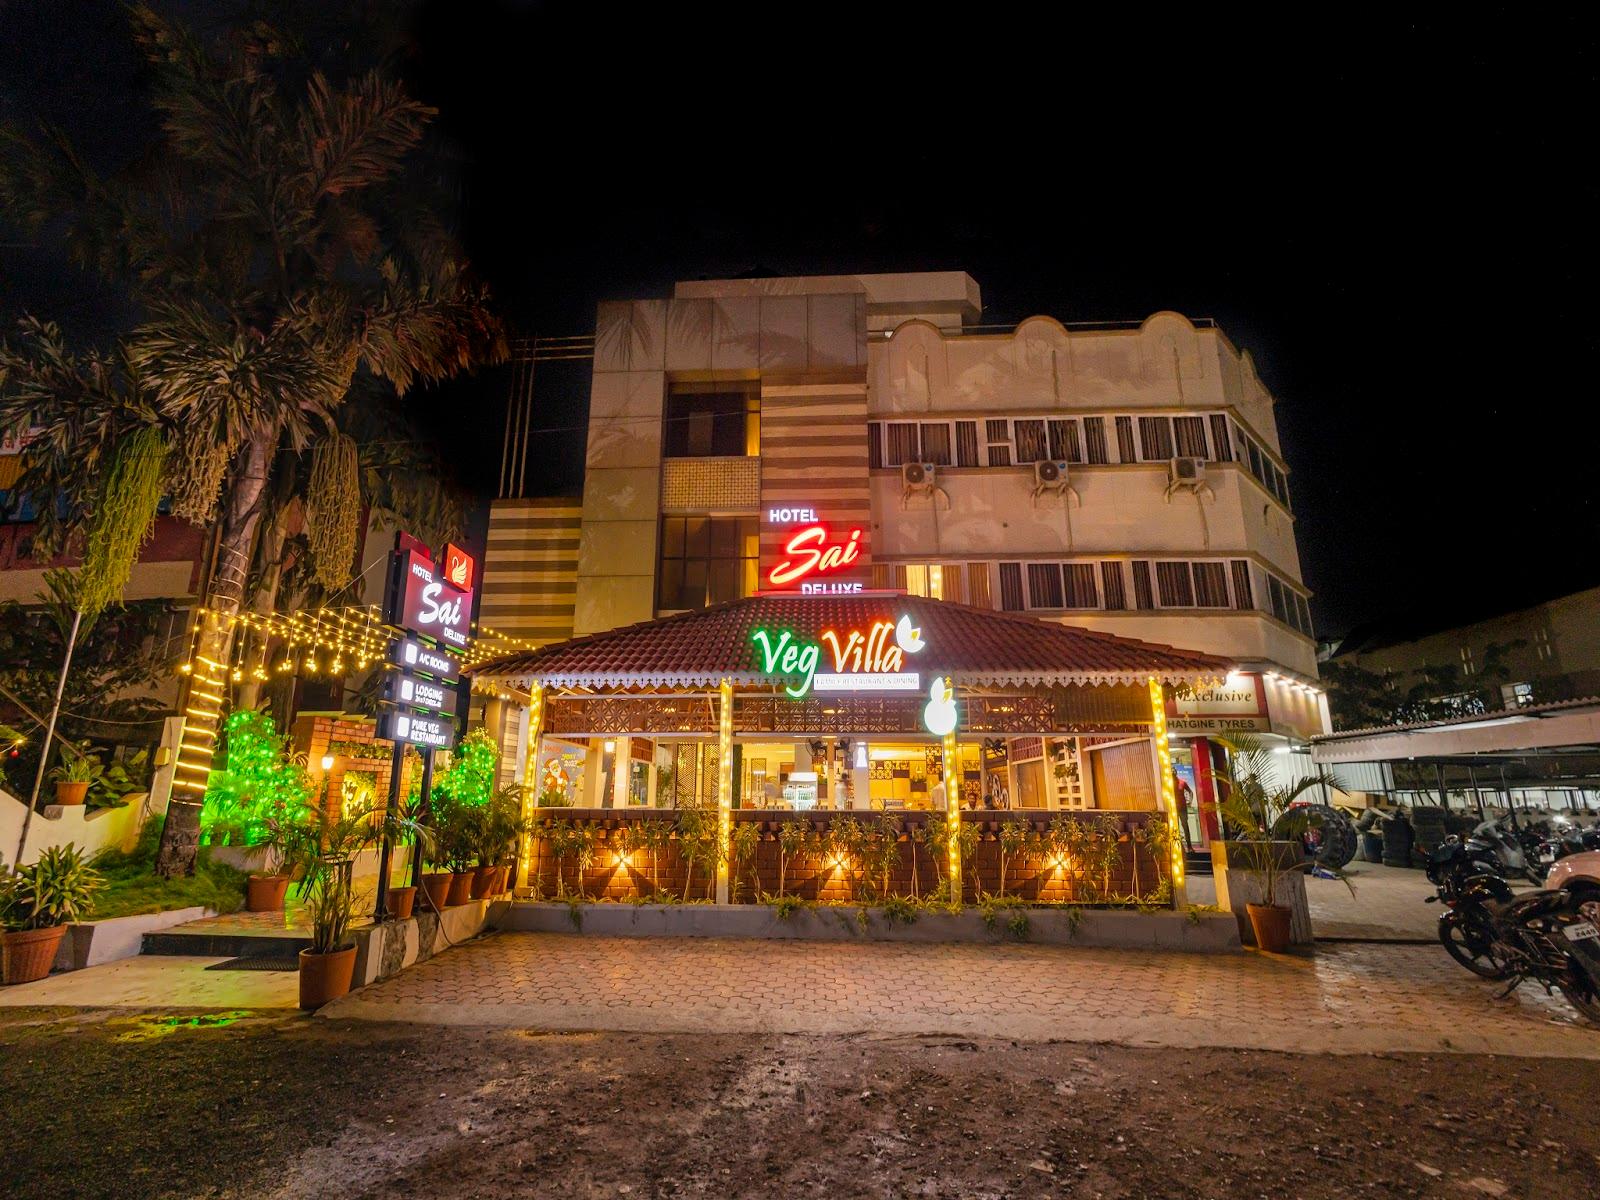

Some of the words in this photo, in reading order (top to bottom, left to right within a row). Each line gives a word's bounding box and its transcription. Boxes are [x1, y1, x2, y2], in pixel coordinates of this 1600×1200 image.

[769, 508, 819, 522] HOTEL
[769, 527, 861, 585] Sai
[412, 563, 433, 584] HOTEL
[801, 583, 863, 595] DELUXE
[418, 582, 462, 625] Sai
[443, 627, 466, 645] DELUXE
[752, 630, 820, 698] Veg
[821, 622, 903, 673] Villa
[415, 683, 443, 702] LODGING
[411, 719, 428, 731] PURE
[428, 722, 440, 734] VEG
[1219, 719, 1255, 729] TYRES
[410, 730, 446, 745] RESTAURANT
